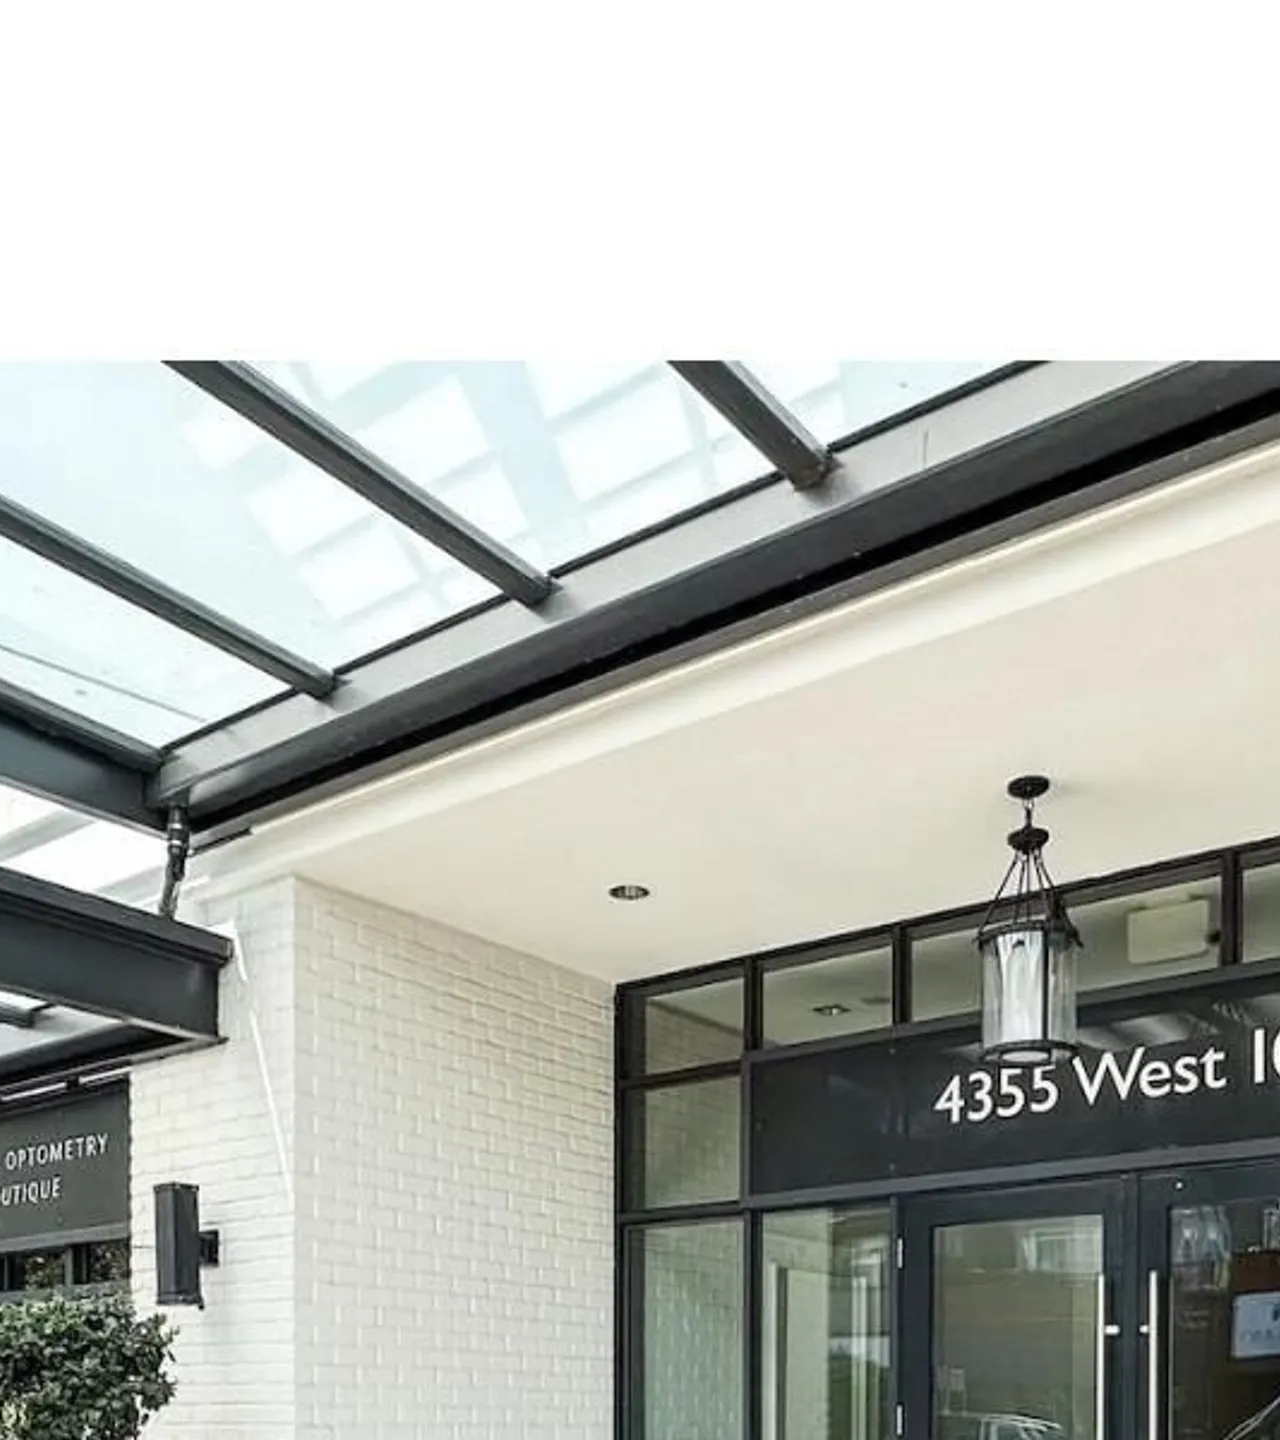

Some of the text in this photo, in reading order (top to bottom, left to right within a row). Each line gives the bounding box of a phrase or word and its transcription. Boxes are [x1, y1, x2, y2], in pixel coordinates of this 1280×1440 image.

[934, 1065, 1059, 1123] 4355
[1072, 1046, 1227, 1105] West
[5, 1133, 109, 1170] OPTOMETRY
